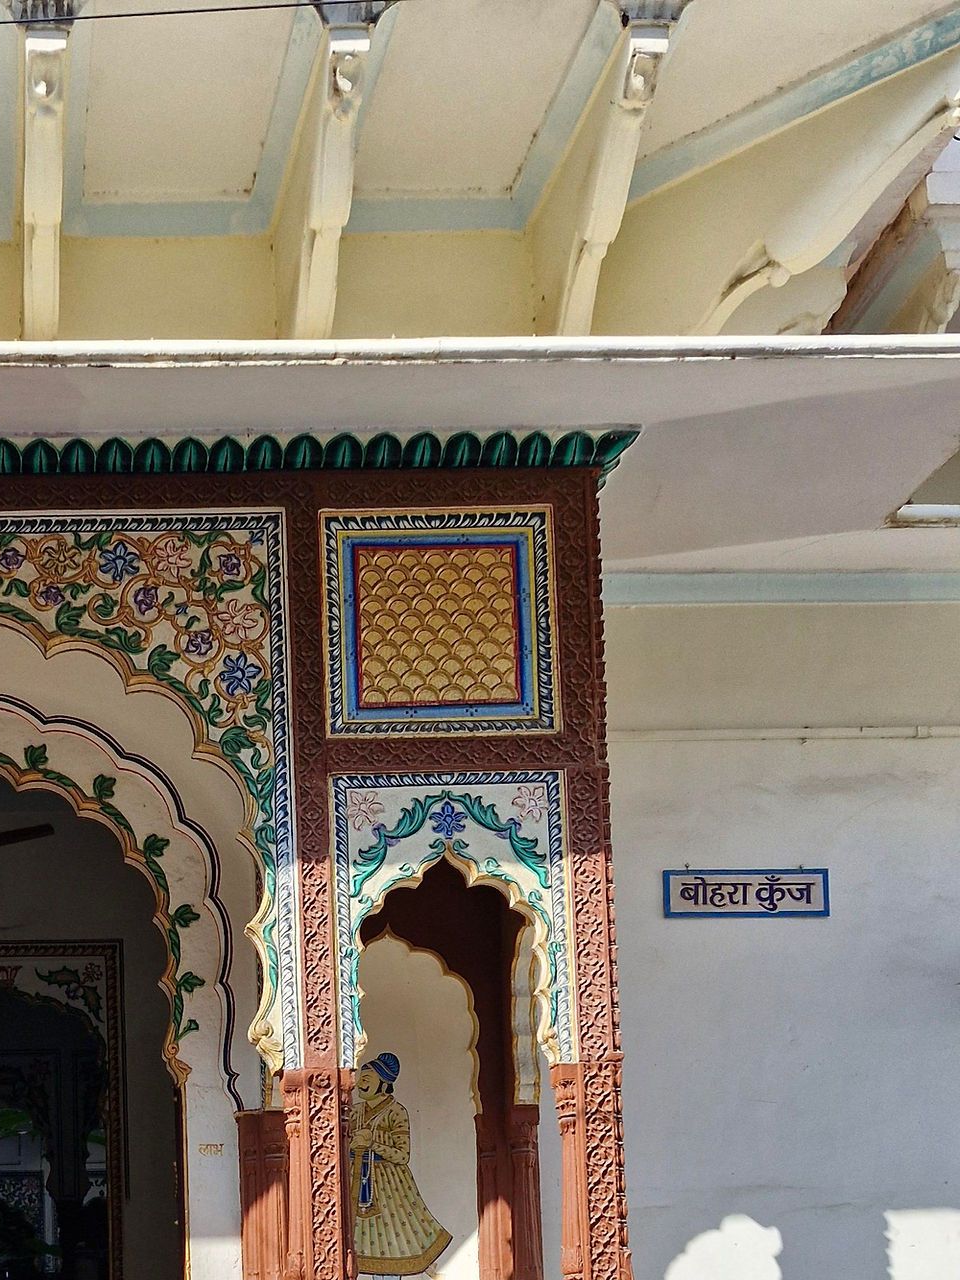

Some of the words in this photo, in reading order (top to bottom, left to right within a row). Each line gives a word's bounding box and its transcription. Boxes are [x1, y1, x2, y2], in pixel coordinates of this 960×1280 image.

[680, 877, 752, 907] बोहरा
[755, 875, 815, 911] कुँज
[198, 1143, 224, 1157] लाभ
